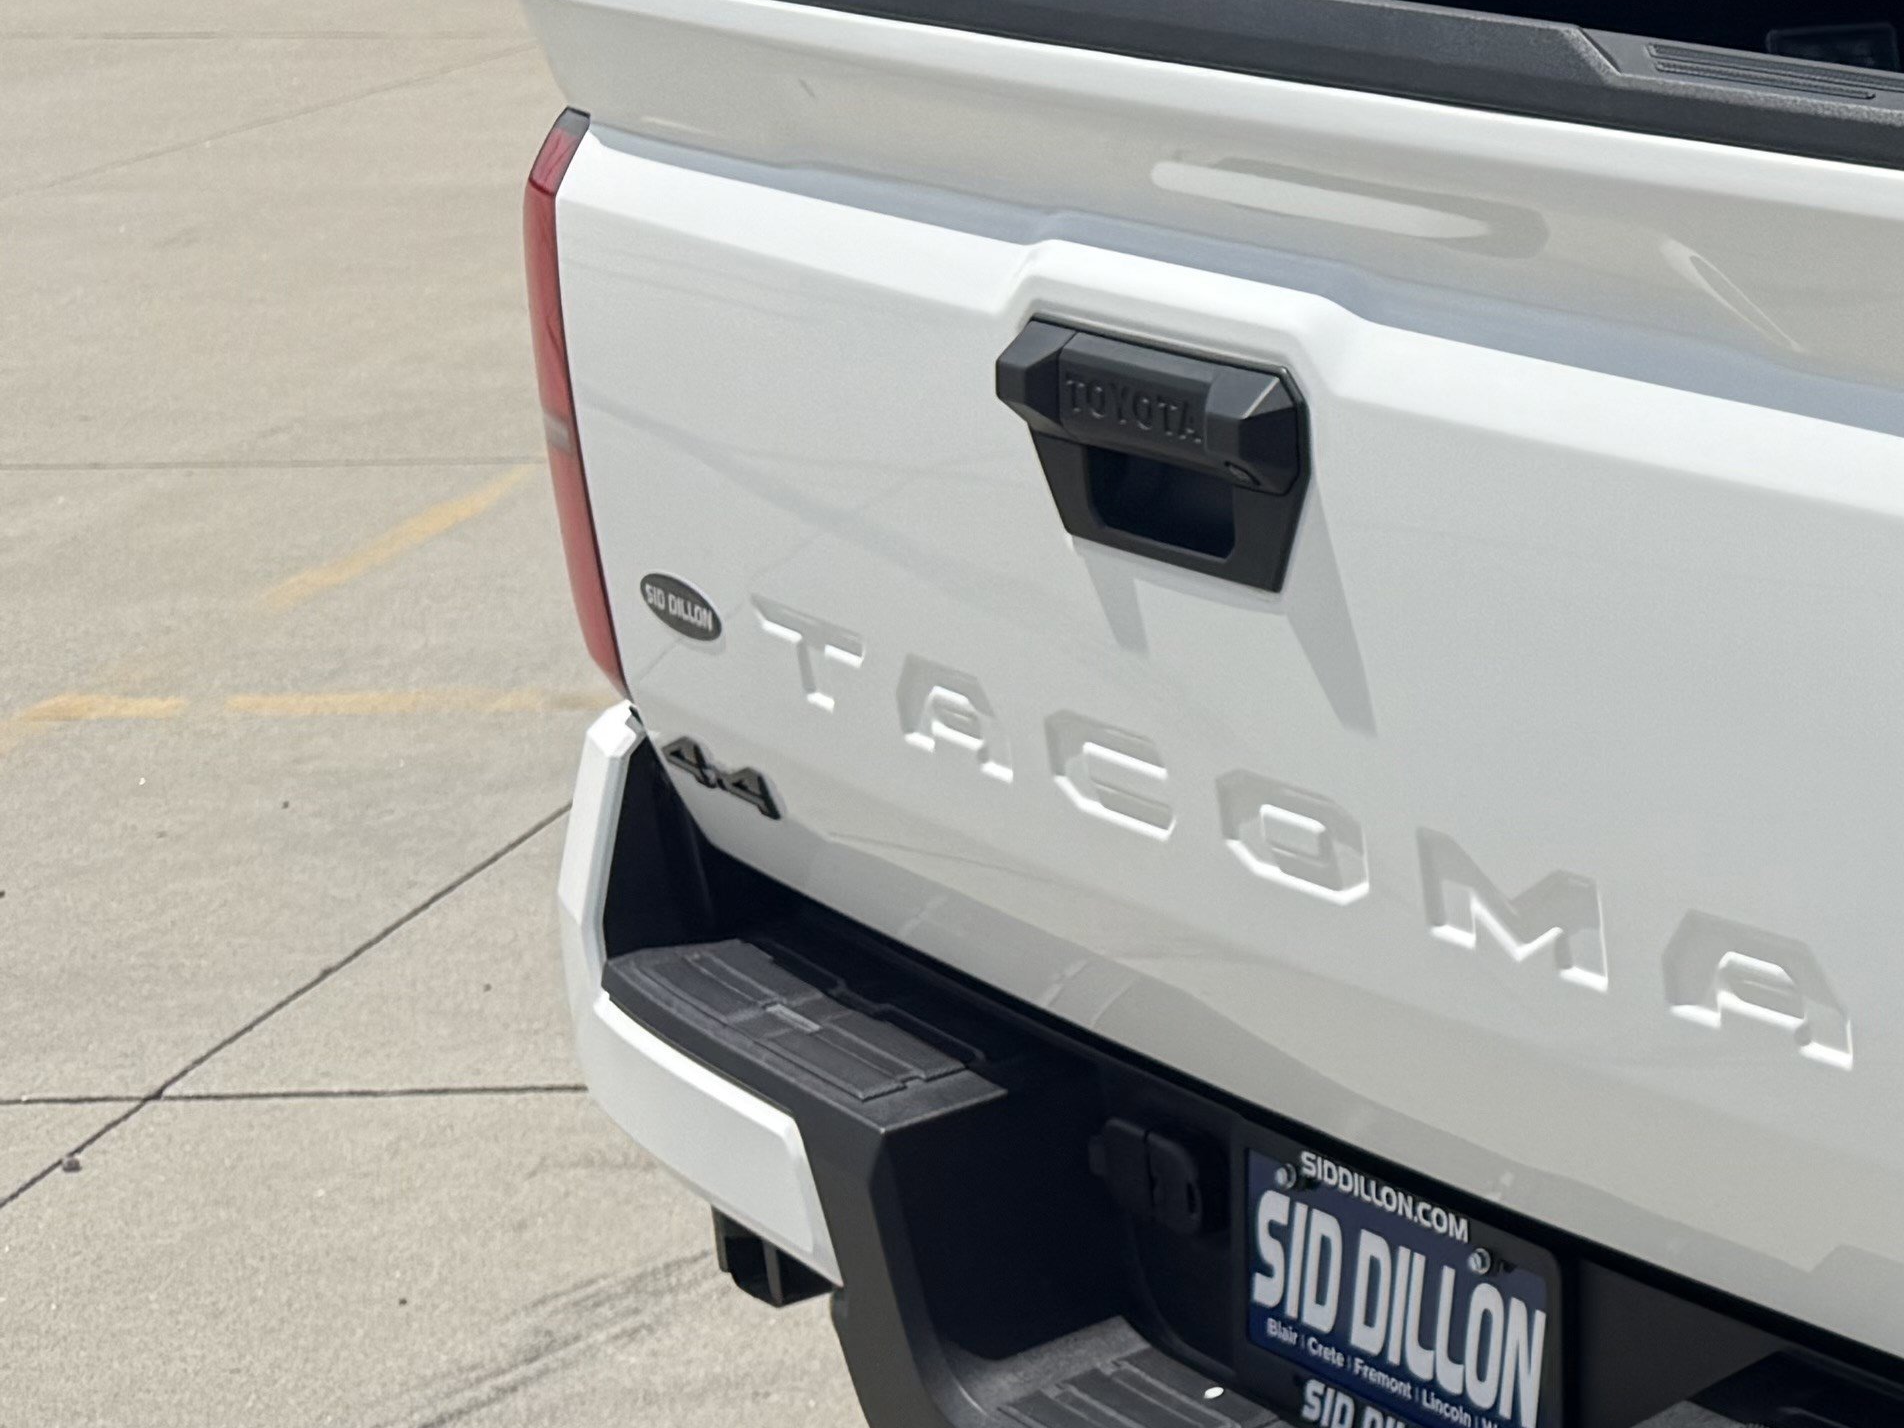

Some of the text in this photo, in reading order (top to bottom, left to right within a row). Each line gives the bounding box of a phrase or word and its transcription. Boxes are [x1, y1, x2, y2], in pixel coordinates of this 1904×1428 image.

[1065, 375, 1203, 444] TOYOTA
[645, 584, 713, 632] SID DILLON
[750, 592, 1853, 1070] TACOMA
[1301, 1150, 1469, 1243] SIDDILLON.COM
[1252, 1189, 1343, 1335] SID
[1266, 1317, 1299, 1346] Blair
[1306, 1336, 1345, 1367] Crete
[1353, 1357, 1414, 1400] Fremont
[1421, 1388, 1473, 1428] Lincoln
